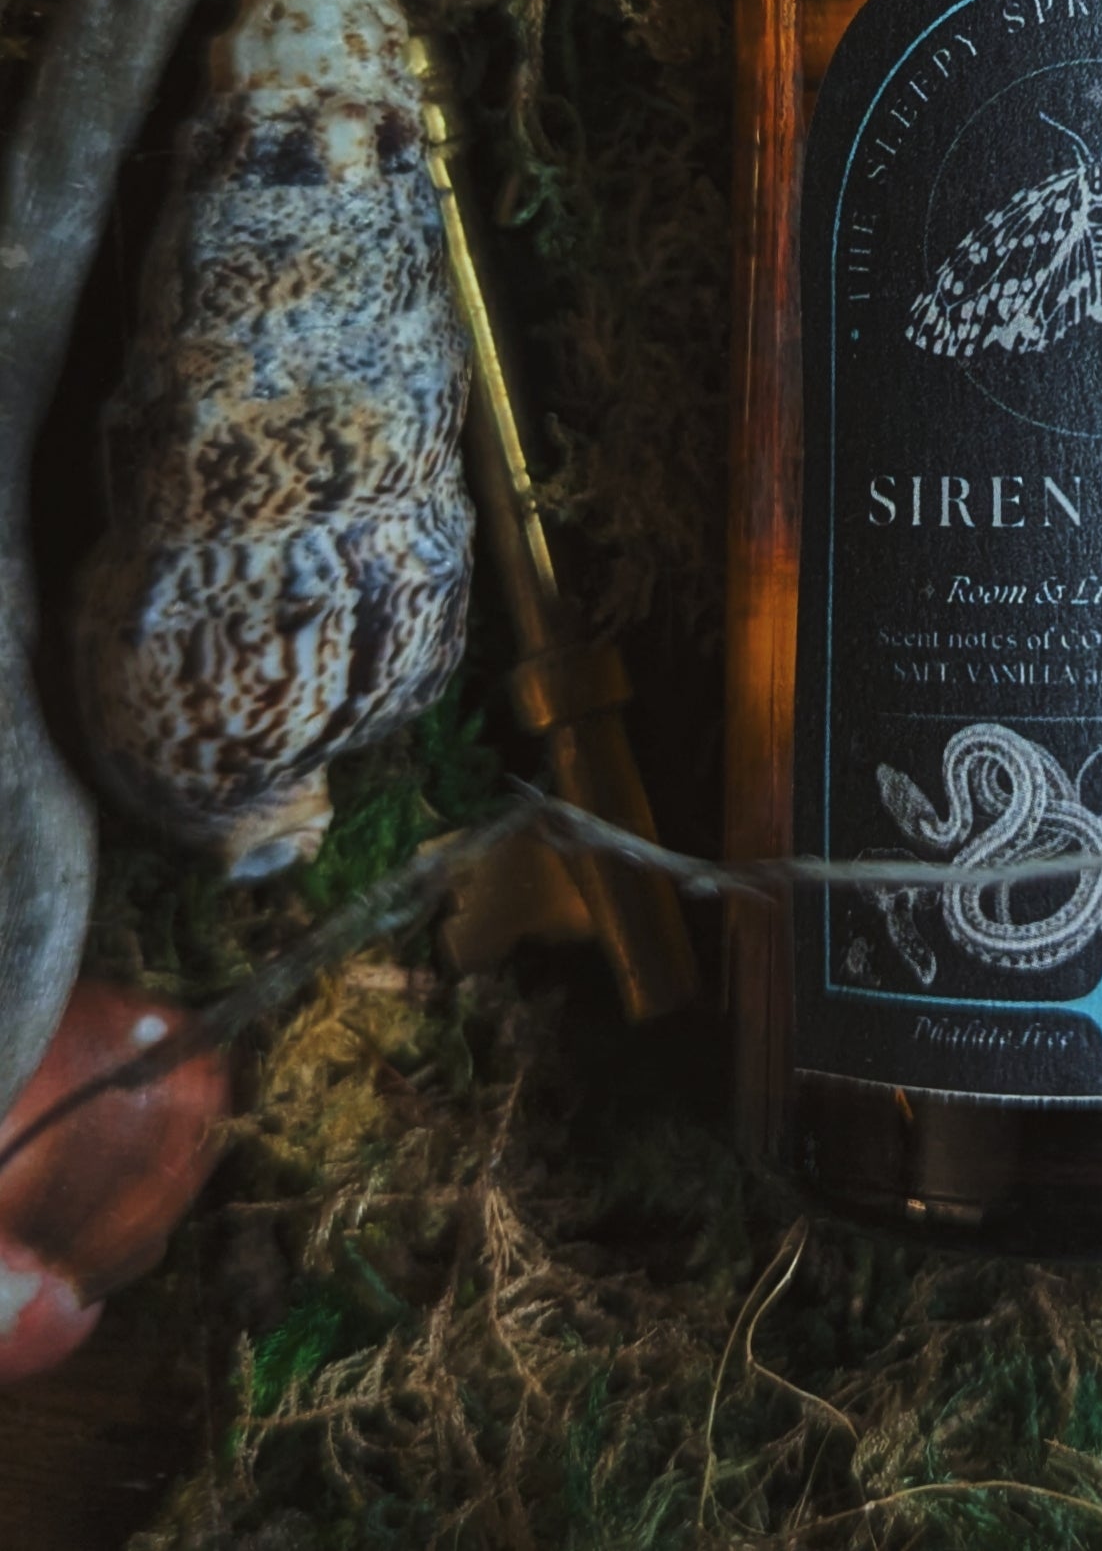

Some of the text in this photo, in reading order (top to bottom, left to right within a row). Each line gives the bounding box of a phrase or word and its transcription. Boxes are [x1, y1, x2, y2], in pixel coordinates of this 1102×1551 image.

[866, 30, 982, 181] SLEEPY
[869, 474, 1083, 527] SIREN
[947, 575, 1027, 604] Room
[1035, 576, 1066, 604] &
[949, 631, 1018, 650] notes
[1026, 626, 1056, 650] of
[966, 661, 1080, 685] VANILLA
